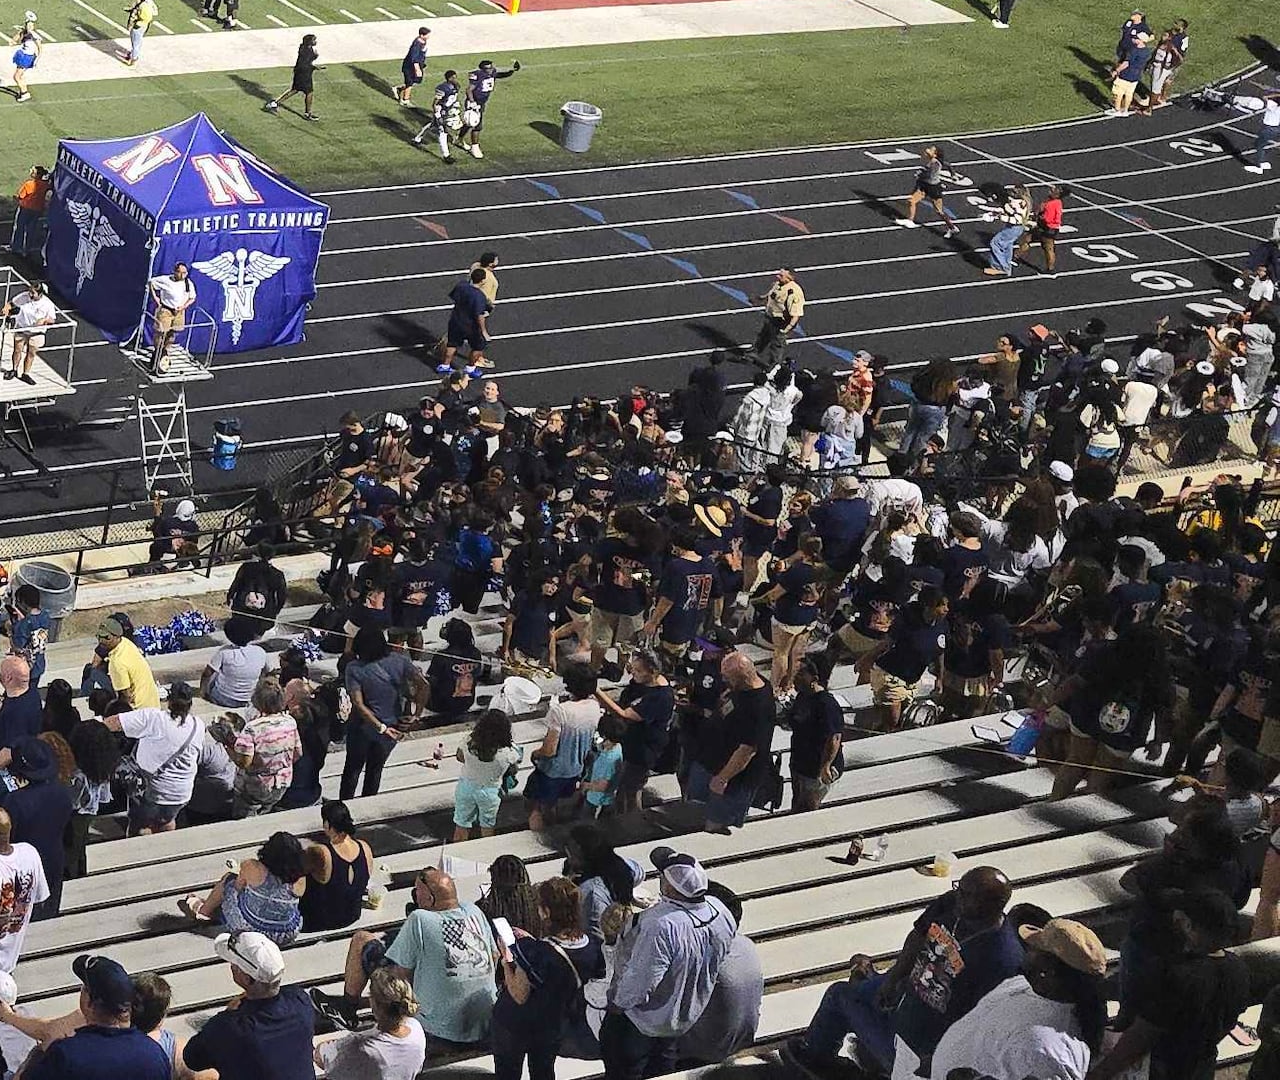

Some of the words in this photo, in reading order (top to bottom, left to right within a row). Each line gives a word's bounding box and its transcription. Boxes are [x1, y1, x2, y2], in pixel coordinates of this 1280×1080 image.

[102, 135, 182, 186] N
[193, 152, 266, 207] N
[58, 147, 104, 191] ATHLETIC
[104, 184, 154, 232] TRAINING
[162, 212, 240, 235] ATHLETIC
[247, 211, 324, 230] TRAINING
[221, 284, 256, 322] N
